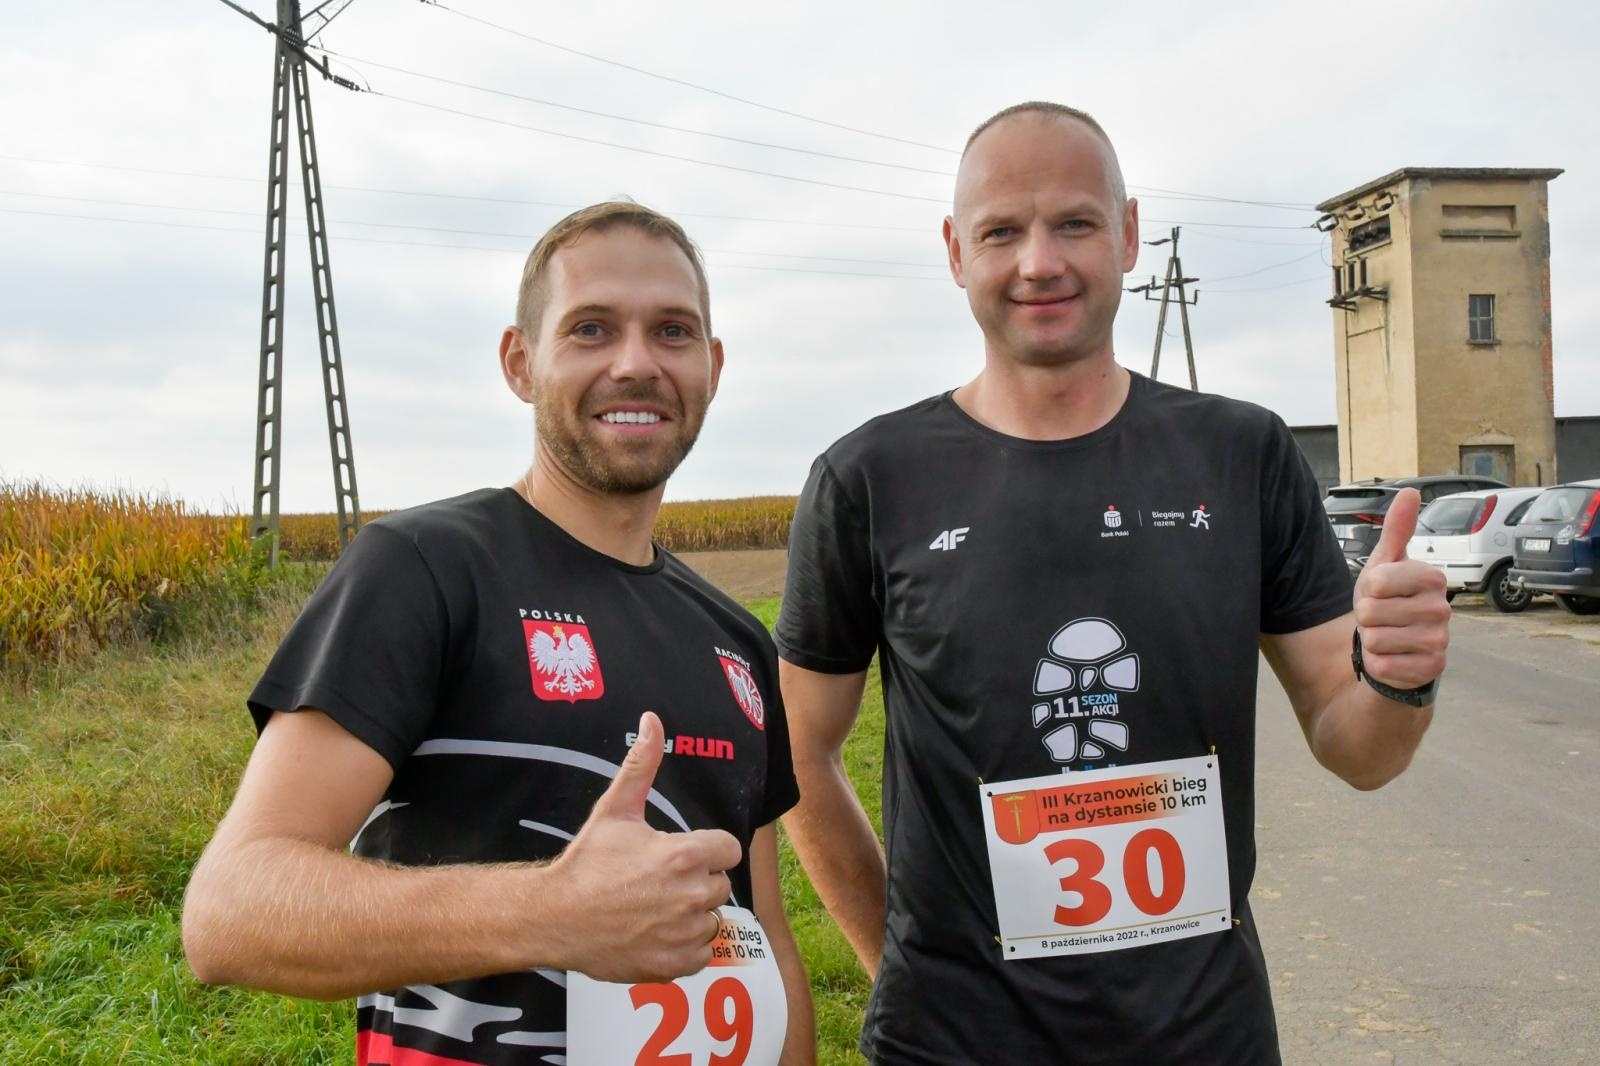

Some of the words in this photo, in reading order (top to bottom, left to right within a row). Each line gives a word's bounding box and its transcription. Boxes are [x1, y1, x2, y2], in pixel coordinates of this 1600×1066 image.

[929, 527, 970, 551] 4F
[519, 608, 585, 624] POLSKA
[1053, 697, 1090, 719] 11.
[1081, 693, 1118, 705] SEZON
[1091, 704, 1119, 716] AKCJI
[625, 732, 734, 759] EyRUN
[1042, 795, 1058, 809] III
[1064, 781, 1169, 806] Krzanowicki
[1173, 776, 1207, 794] bieg
[1048, 812, 1070, 825] na
[1075, 800, 1157, 823] dystansie
[1161, 797, 1177, 810] 10
[1181, 793, 1207, 808] km
[1043, 828, 1186, 927] 30
[737, 926, 762, 945] bieg
[1041, 940, 1048, 949] 8
[1117, 931, 1139, 941] 2022
[1150, 921, 1200, 935] Krzanowice
[733, 944, 746, 959] 10
[747, 944, 766, 960] km
[628, 976, 754, 1066] 29
